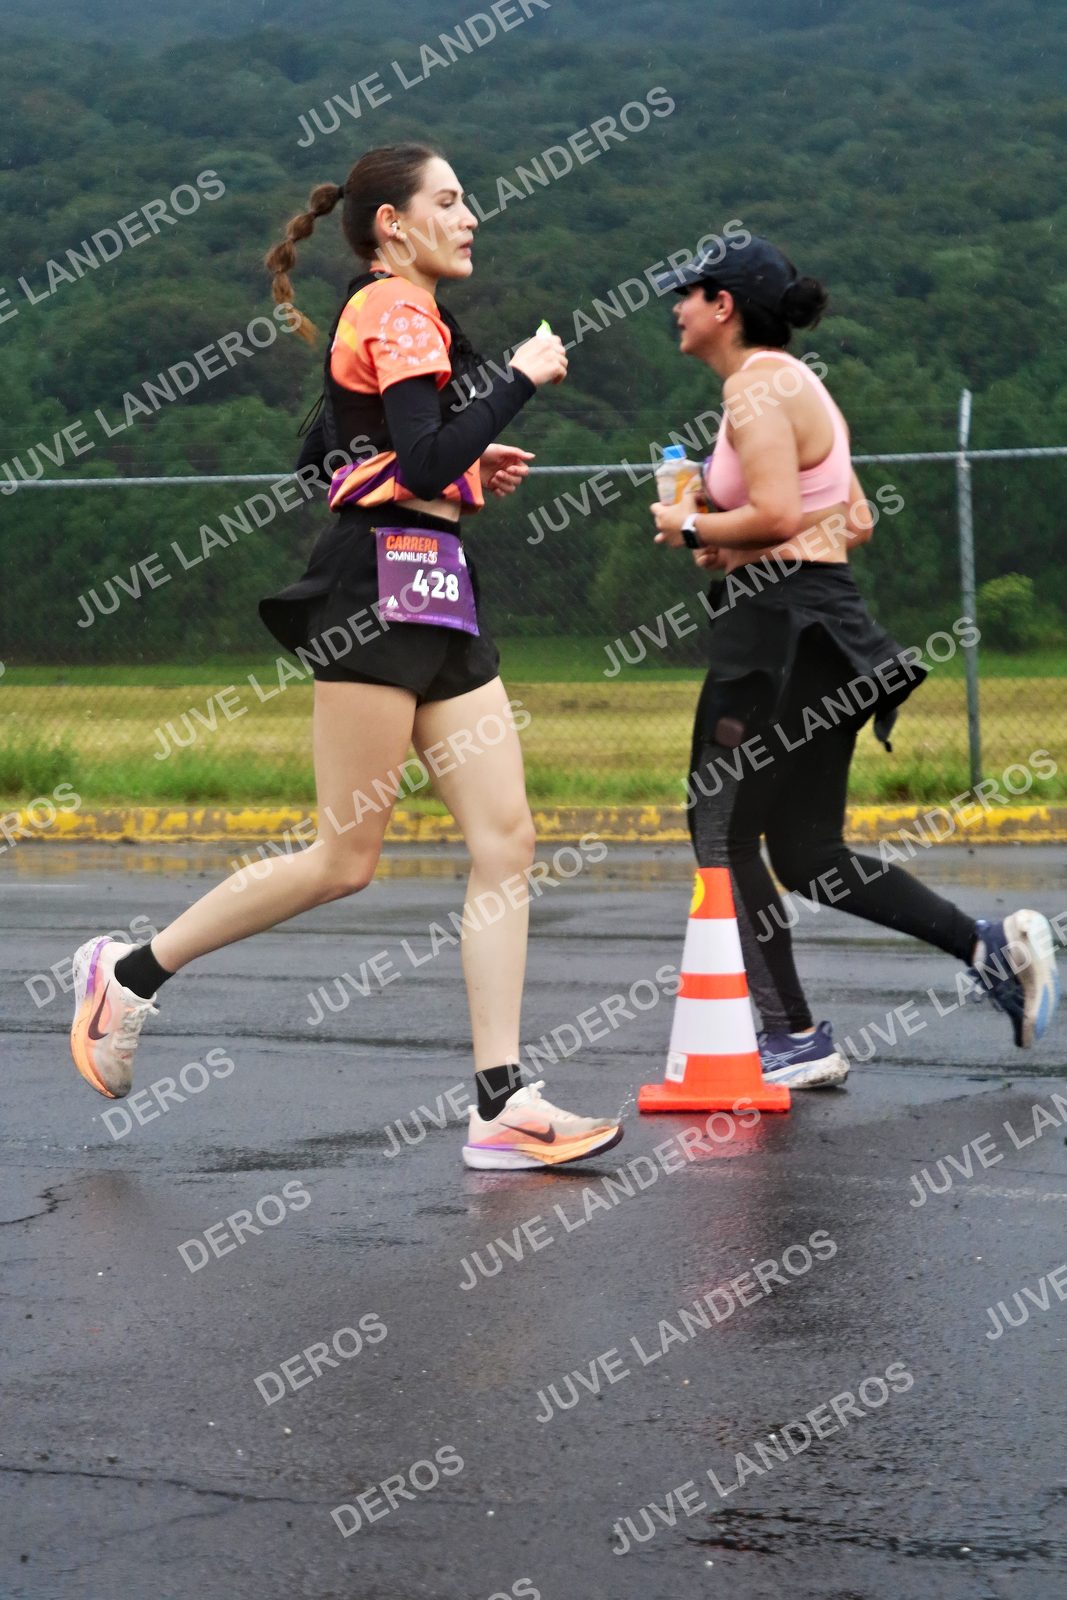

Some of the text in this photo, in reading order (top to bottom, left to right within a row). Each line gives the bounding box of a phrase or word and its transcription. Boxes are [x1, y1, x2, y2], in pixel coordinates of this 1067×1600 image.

[386, 535, 438, 552] CARRERA
[386, 551, 427, 563] OMNILIFE
[412, 569, 459, 602] 428
